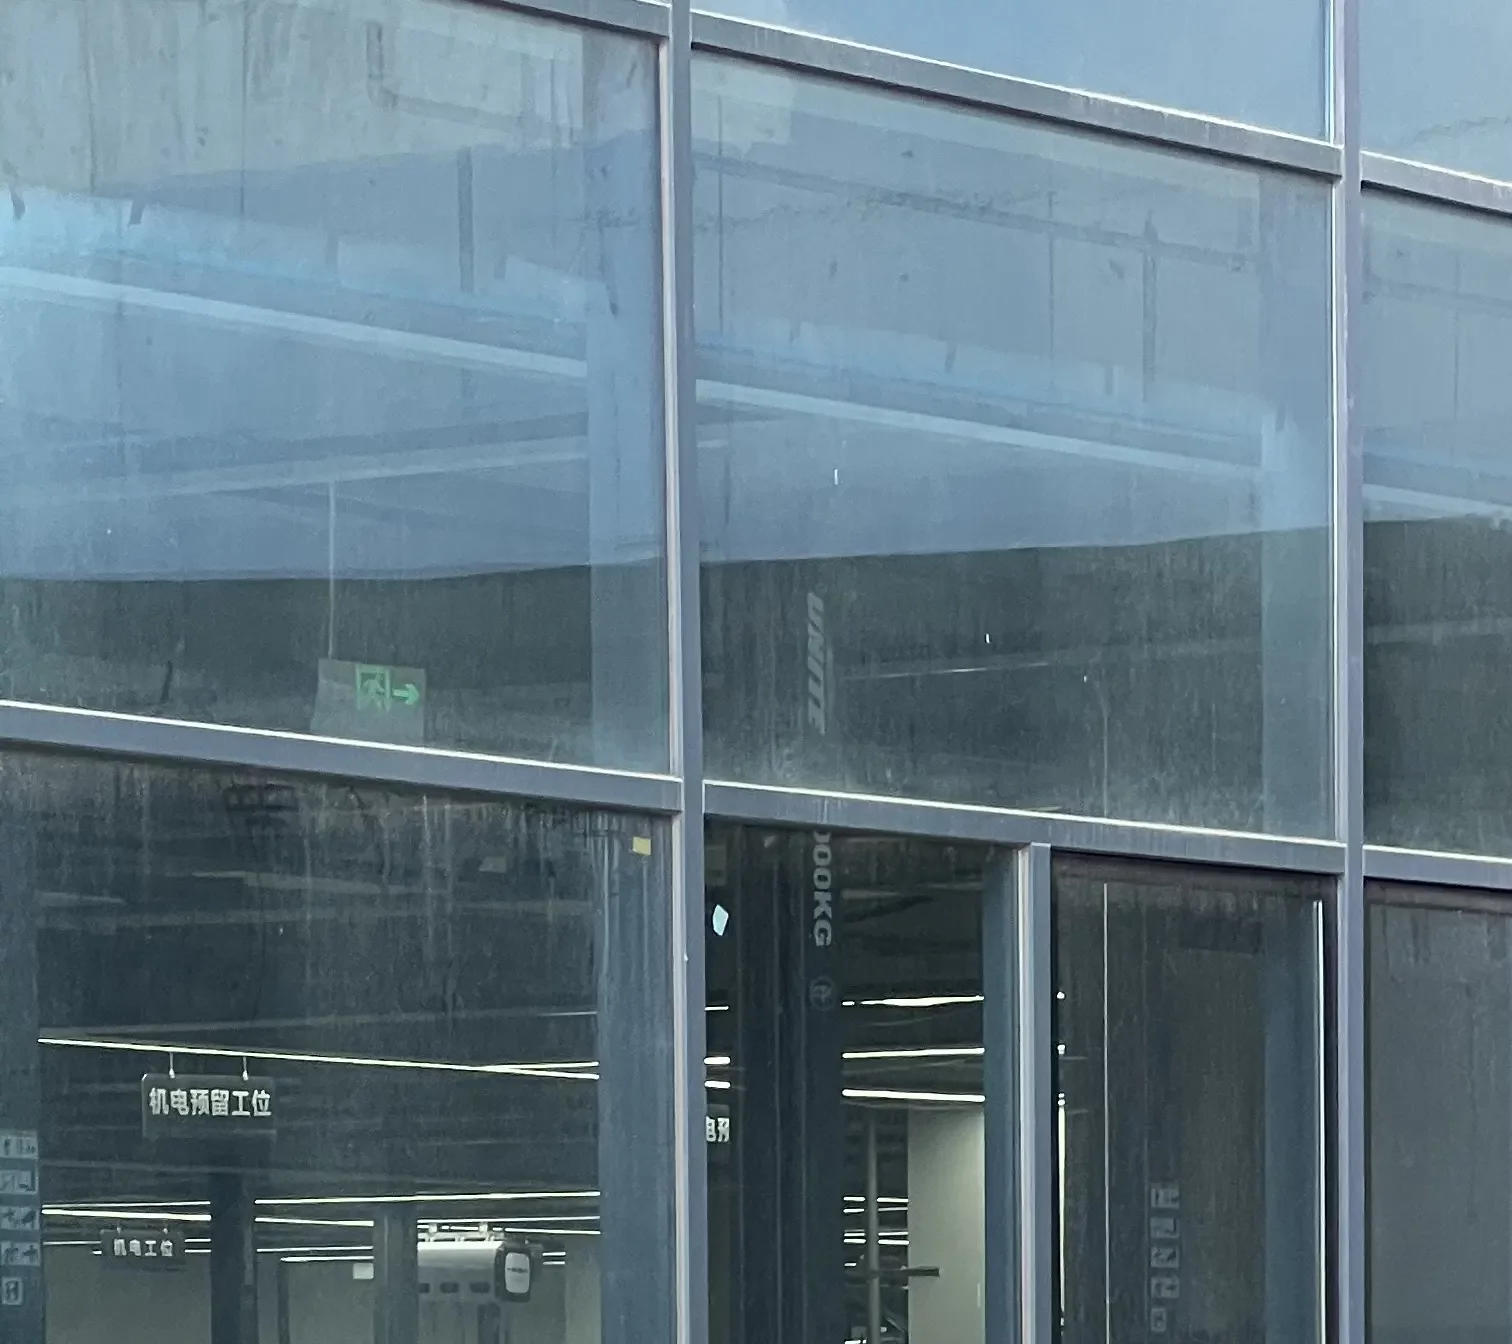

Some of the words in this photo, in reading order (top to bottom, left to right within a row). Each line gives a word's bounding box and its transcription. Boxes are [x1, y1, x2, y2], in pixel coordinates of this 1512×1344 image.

[148, 1086, 273, 1117] 机电预留工位
